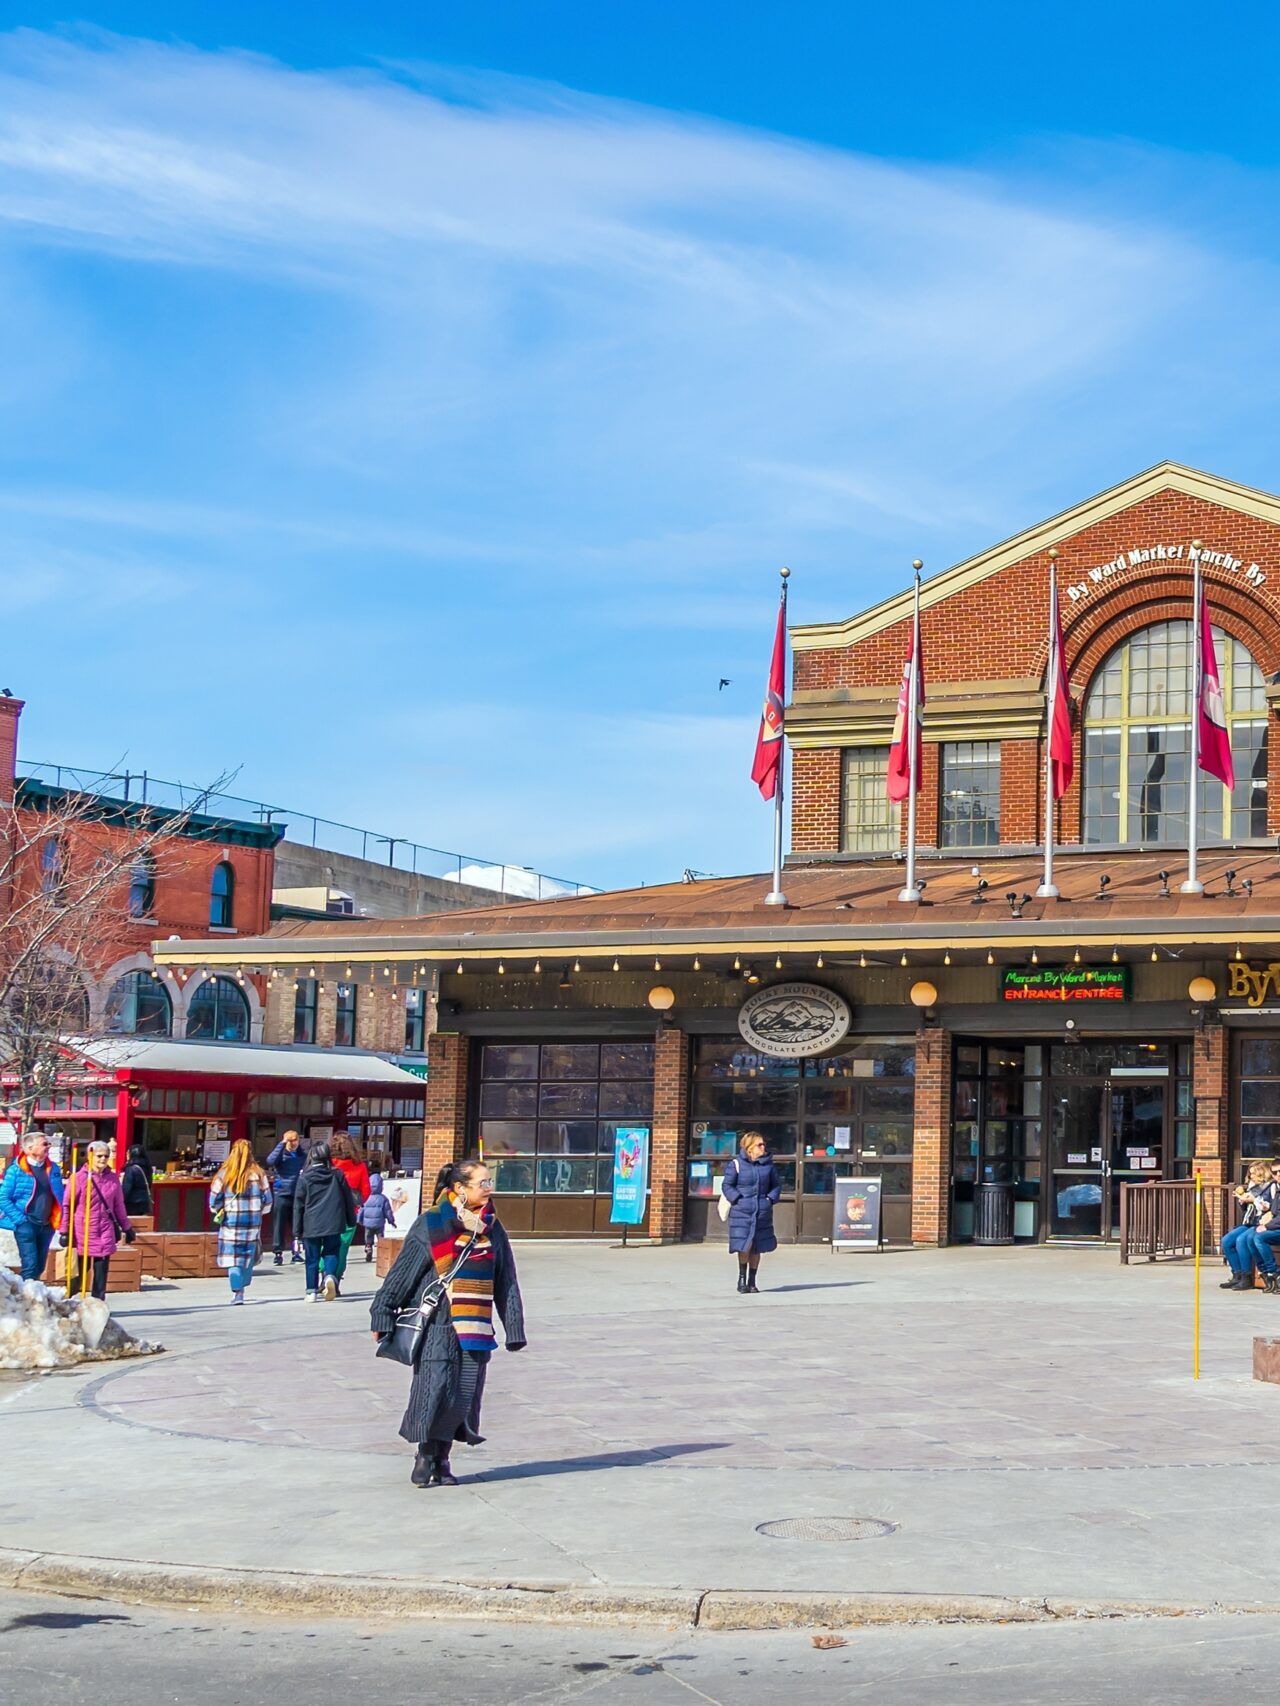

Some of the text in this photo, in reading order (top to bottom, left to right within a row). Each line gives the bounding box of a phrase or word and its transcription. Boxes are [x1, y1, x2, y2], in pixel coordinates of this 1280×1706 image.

[1066, 582, 1090, 601] By
[1088, 554, 1127, 583] Ward
[1128, 544, 1184, 567] Market
[1245, 562, 1267, 587] By
[1044, 972, 1059, 985] By
[1060, 971, 1086, 983] Ward
[745, 986, 843, 1012] ROCKY MOUNTAIN
[745, 1028, 840, 1052] CHOCOLATE FACTORY
